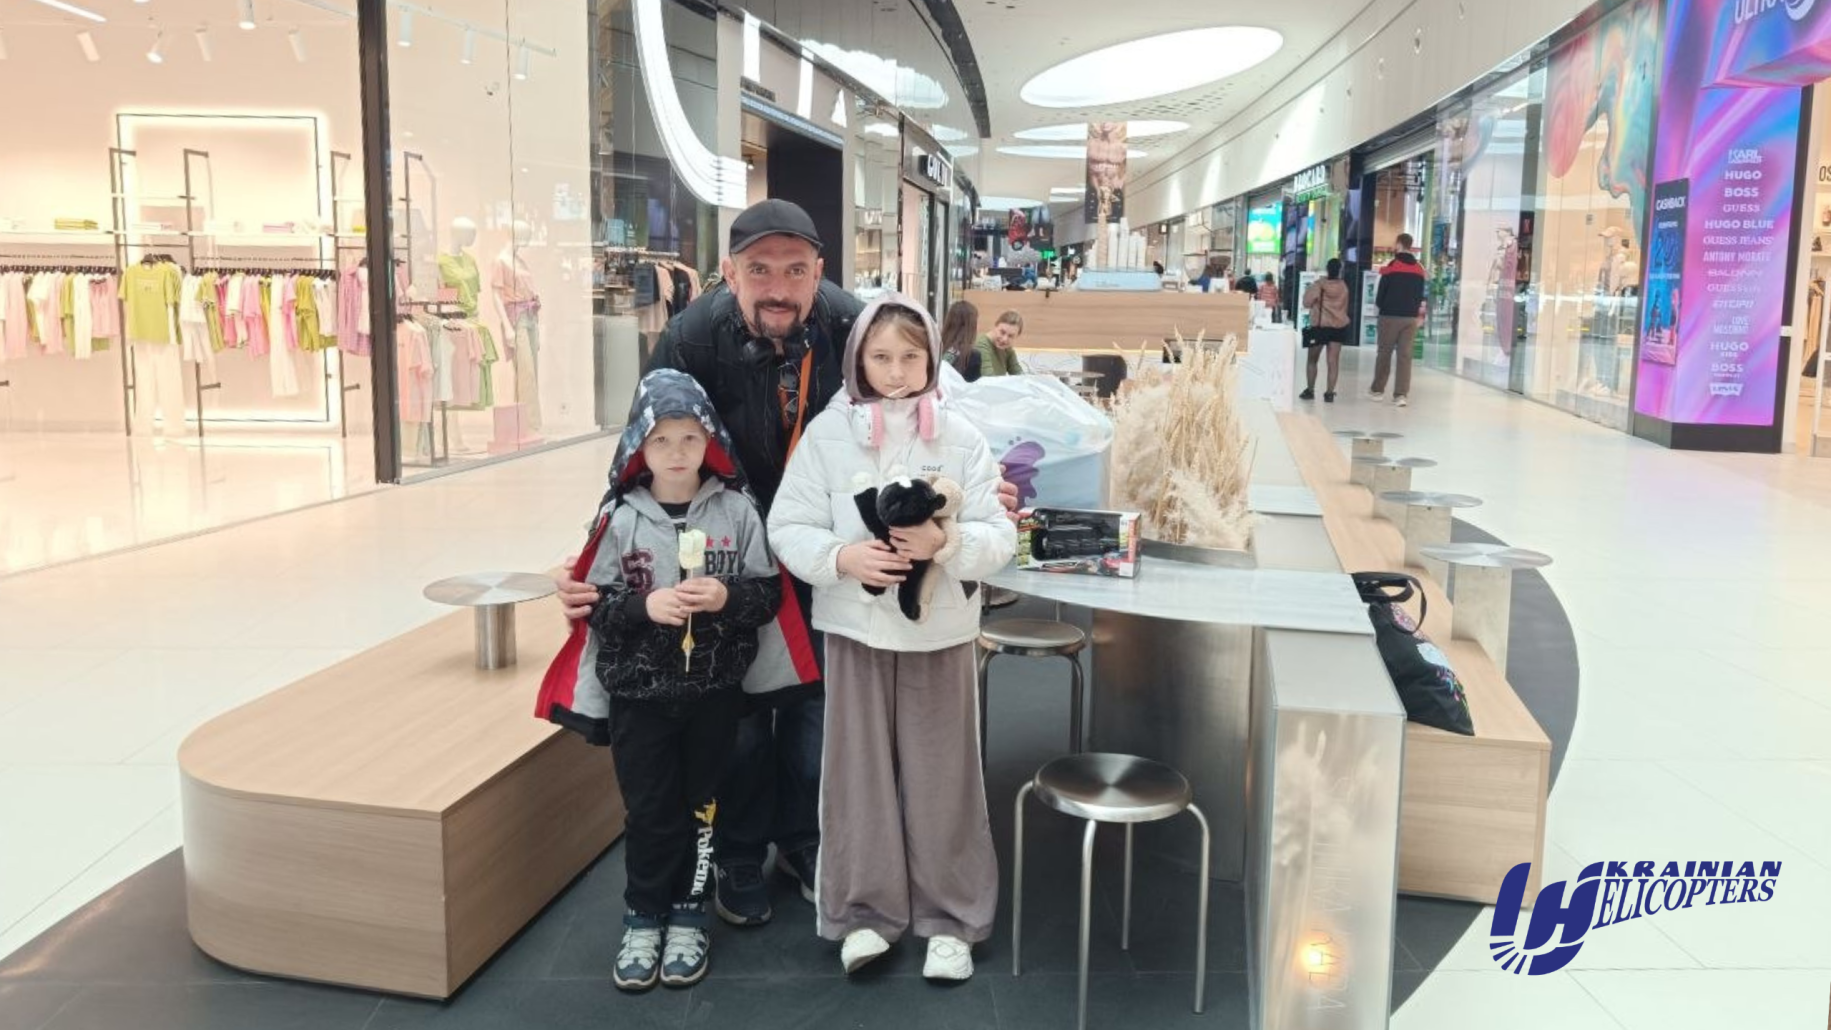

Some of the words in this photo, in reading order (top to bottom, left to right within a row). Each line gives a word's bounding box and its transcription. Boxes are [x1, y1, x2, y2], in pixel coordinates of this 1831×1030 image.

[1725, 170, 1762, 180] HUGO
[1724, 187, 1759, 198] BOSS
[1723, 203, 1760, 213] GUESS
[1704, 219, 1741, 229] HUGO
[1742, 219, 1774, 229] BLUE
[1702, 235, 1738, 245] GUESS
[1710, 341, 1749, 351] HUGO
[1711, 363, 1744, 373] BOSS
[704, 550, 745, 575] BOY
